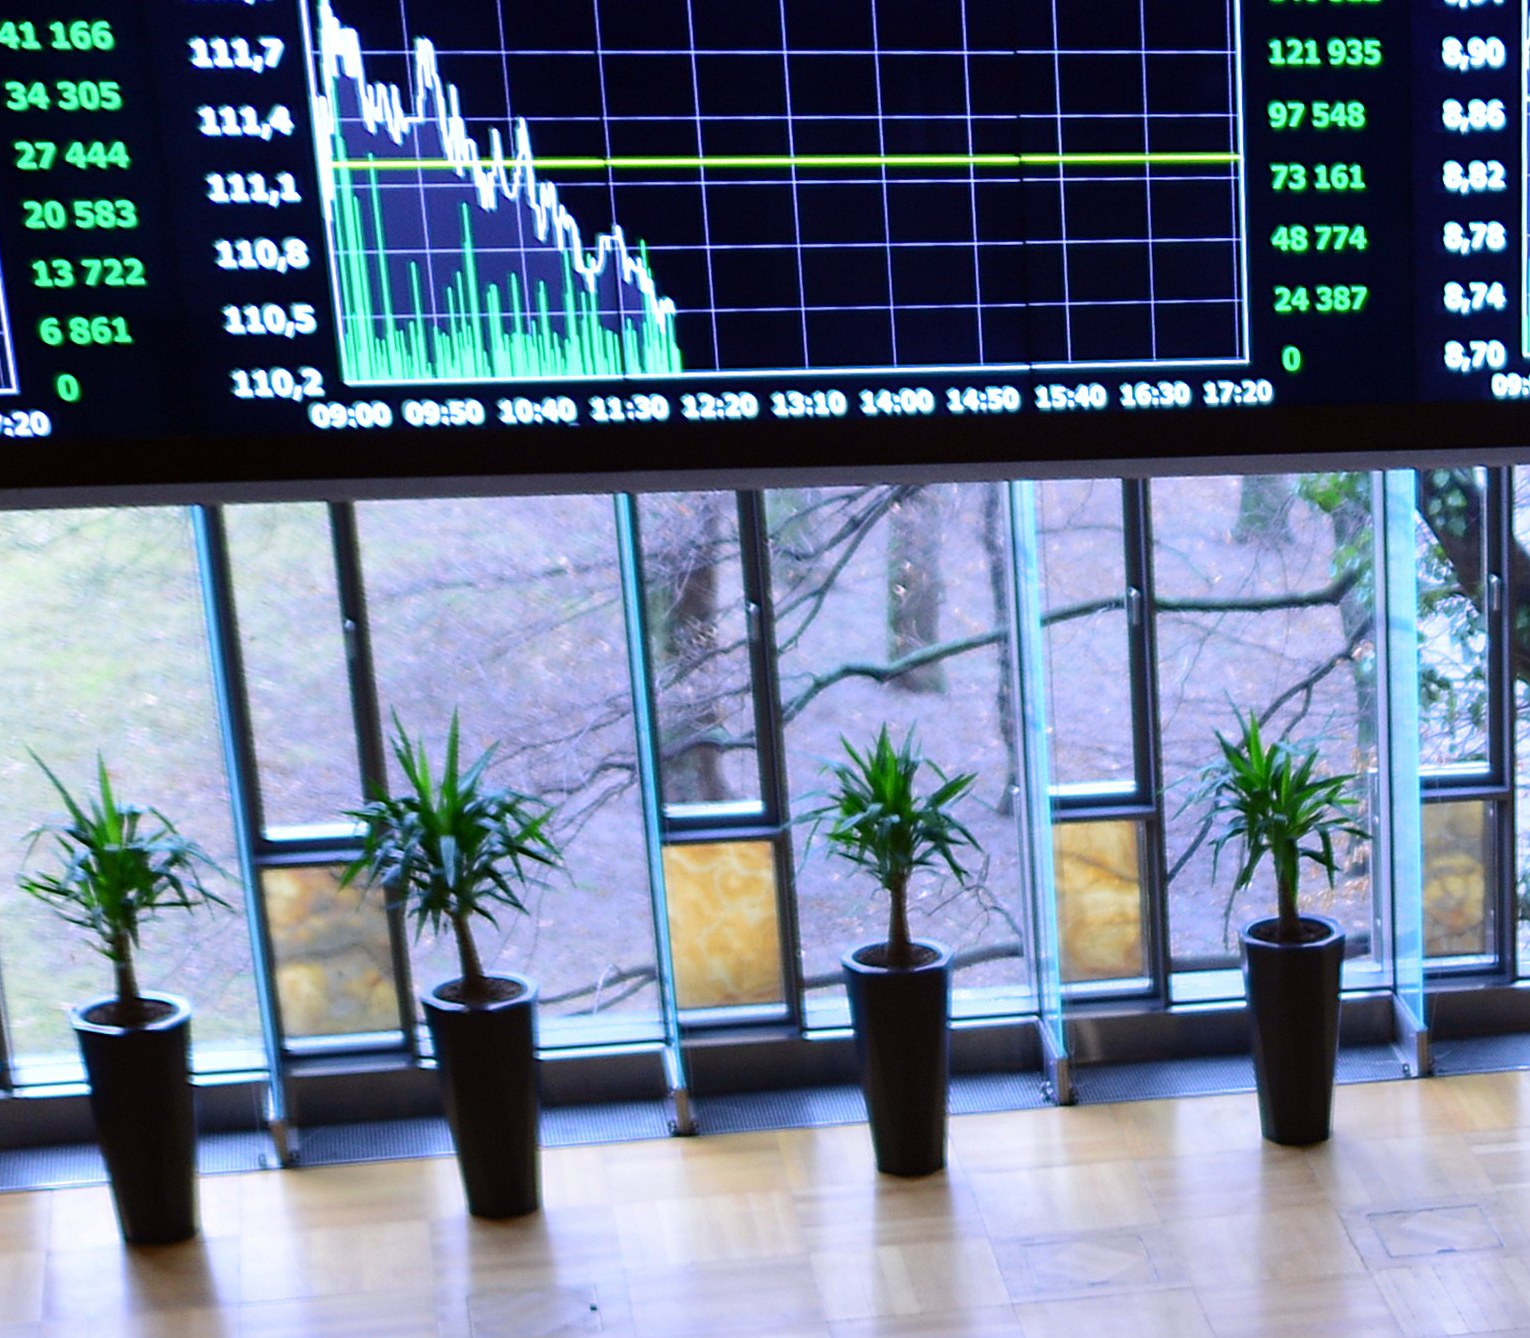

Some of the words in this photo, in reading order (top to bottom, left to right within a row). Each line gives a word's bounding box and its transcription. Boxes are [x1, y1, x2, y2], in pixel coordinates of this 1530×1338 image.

[49, 20, 115, 50] 166
[187, 37, 285, 73] 111,7
[1268, 39, 1320, 66] 121
[1327, 39, 1382, 66] 935
[1442, 36, 1506, 72] 8,90
[5, 81, 50, 110] 34
[57, 81, 122, 110] 305
[196, 104, 295, 140] 111,4
[1268, 101, 1305, 128] 97
[1311, 101, 1366, 128] 548
[1442, 98, 1506, 133] 8,86
[14, 141, 56, 170] 27
[65, 141, 131, 170] 444
[205, 171, 301, 208] 111,1
[1270, 163, 1307, 190] 73
[1314, 163, 1366, 190] 161
[1442, 160, 1507, 194] 8,82
[24, 200, 66, 229] 20
[74, 200, 138, 229] 583
[1271, 225, 1308, 251] 48
[1314, 225, 1367, 251] 774
[1443, 221, 1507, 254] 8,78
[214, 237, 310, 274] 110,8
[32, 258, 74, 287] 13
[81, 258, 147, 287] 722
[1274, 286, 1309, 312] 24
[1315, 286, 1367, 312] 387
[1443, 281, 1507, 315] 8,74
[39, 316, 63, 345] 6
[69, 316, 133, 345] 861
[222, 303, 317, 339] 110,5
[1281, 346, 1301, 372] 0
[1444, 340, 1507, 373] 8,70
[57, 374, 80, 401] 0
[230, 367, 325, 401] 110,2
[309, 401, 392, 429] 09:00
[402, 399, 485, 426] 09:50
[497, 396, 577, 424] 10:40
[589, 394, 669, 422] 11:30
[681, 392, 759, 420] 12:20
[771, 389, 847, 417] 13:10
[859, 387, 934, 415] 14:00
[946, 385, 1021, 413] 14:50
[1034, 383, 1107, 410] 15:40
[1119, 381, 1190, 408] 16:30
[1203, 379, 1274, 406] 17:20
